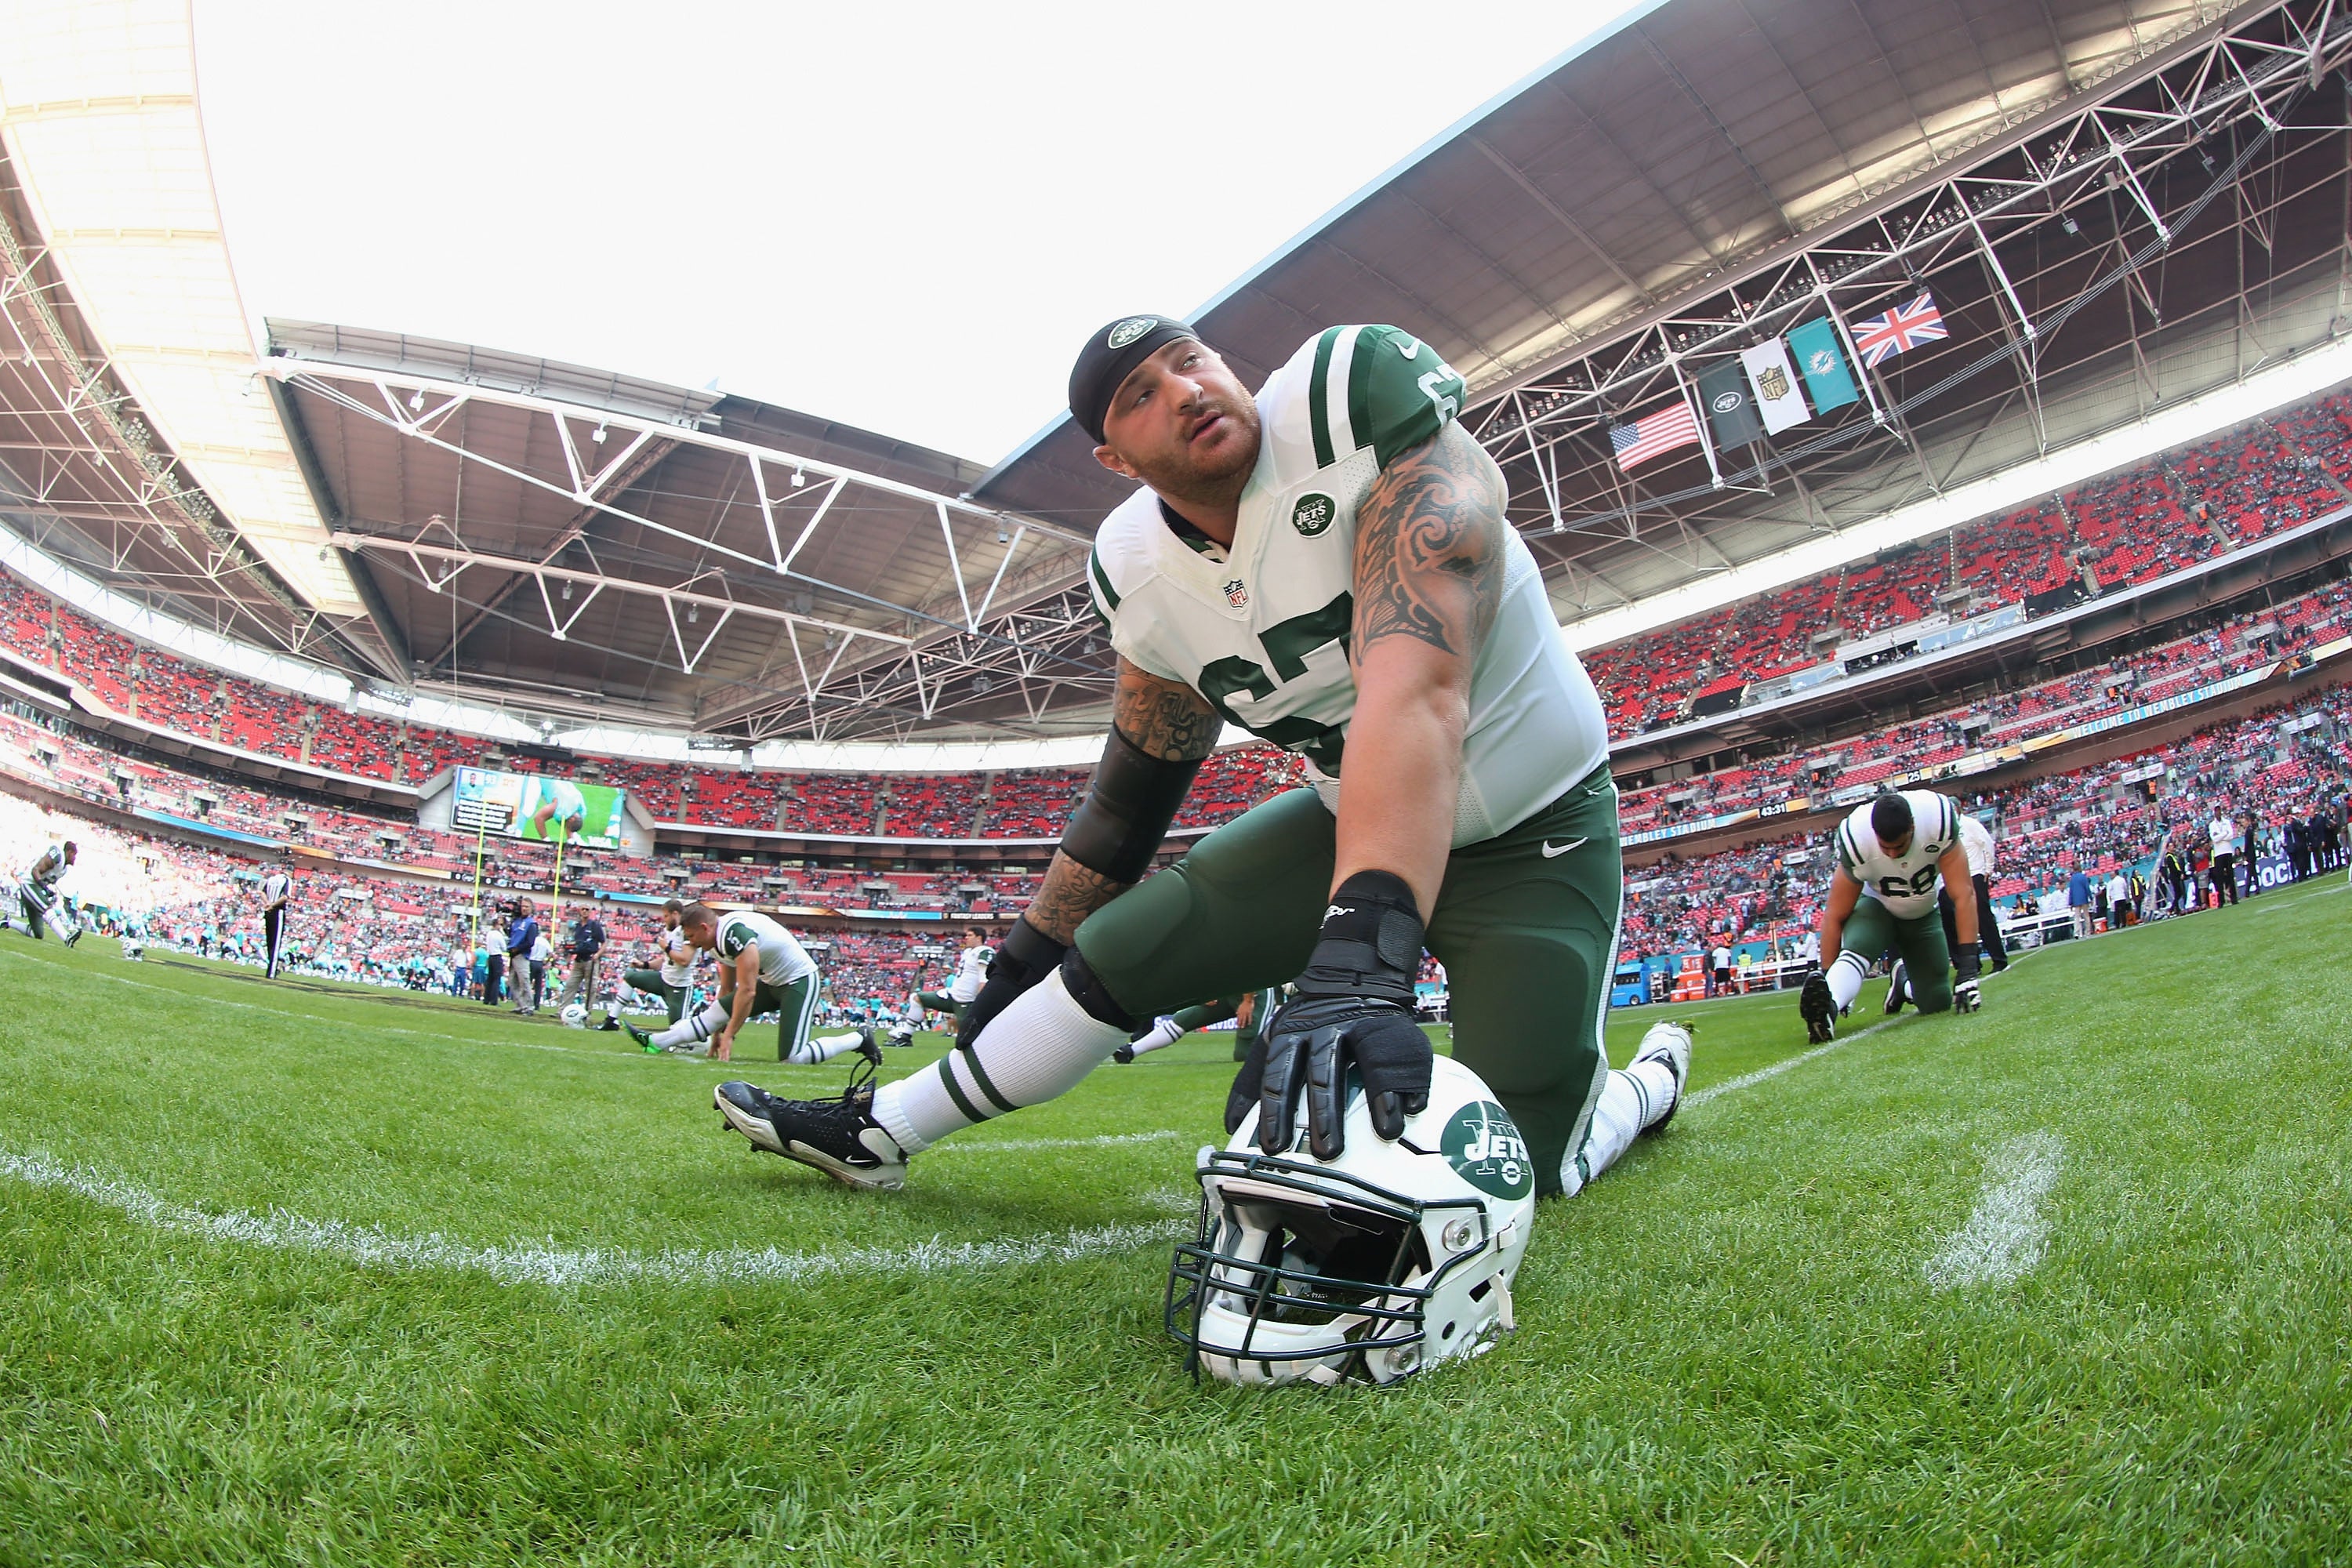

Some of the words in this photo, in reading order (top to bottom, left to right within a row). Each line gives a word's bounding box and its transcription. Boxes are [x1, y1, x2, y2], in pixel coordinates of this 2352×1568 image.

[1417, 363, 1468, 428] 67
[1763, 379, 1788, 398] NFL
[1296, 505, 1326, 525] JETS
[1229, 590, 1247, 605] NFL
[2072, 713, 2128, 738] WELCOME
[2128, 710, 2141, 723] TO
[2144, 691, 2195, 717] WEMBLEY
[2198, 678, 2243, 700] STADIUM
[1907, 771, 1920, 782] 25
[1761, 803, 1785, 816] 43:31
[1671, 818, 1715, 837] STADIUM
[1464, 1129, 1528, 1161] JETS
